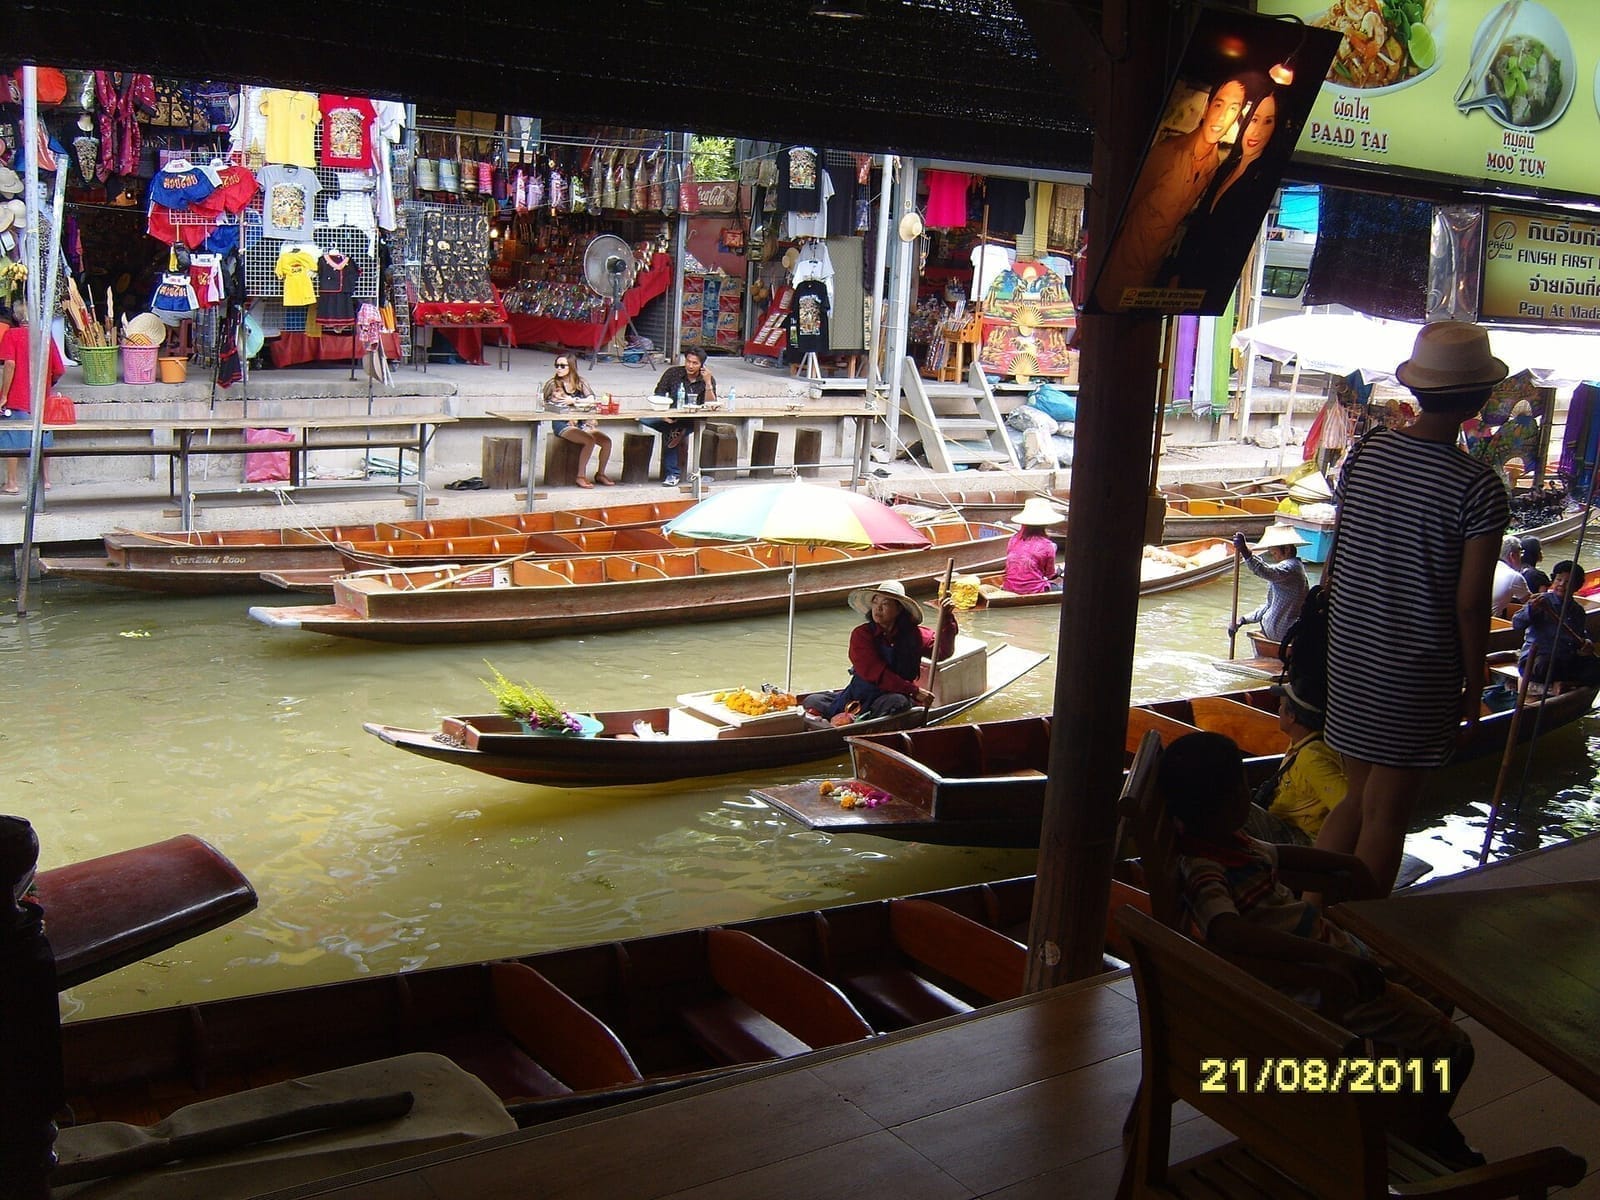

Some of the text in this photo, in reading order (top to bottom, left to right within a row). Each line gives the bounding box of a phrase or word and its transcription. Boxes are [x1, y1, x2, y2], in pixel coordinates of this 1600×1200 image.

[1311, 121, 1388, 149] PAAD TAI
[1486, 152, 1546, 176] MOO TUN
[1487, 240, 1514, 251] PAEW
[1517, 249, 1594, 270] FINISH FIRST
[1519, 301, 1544, 319] Pay
[1549, 303, 1565, 318] At
